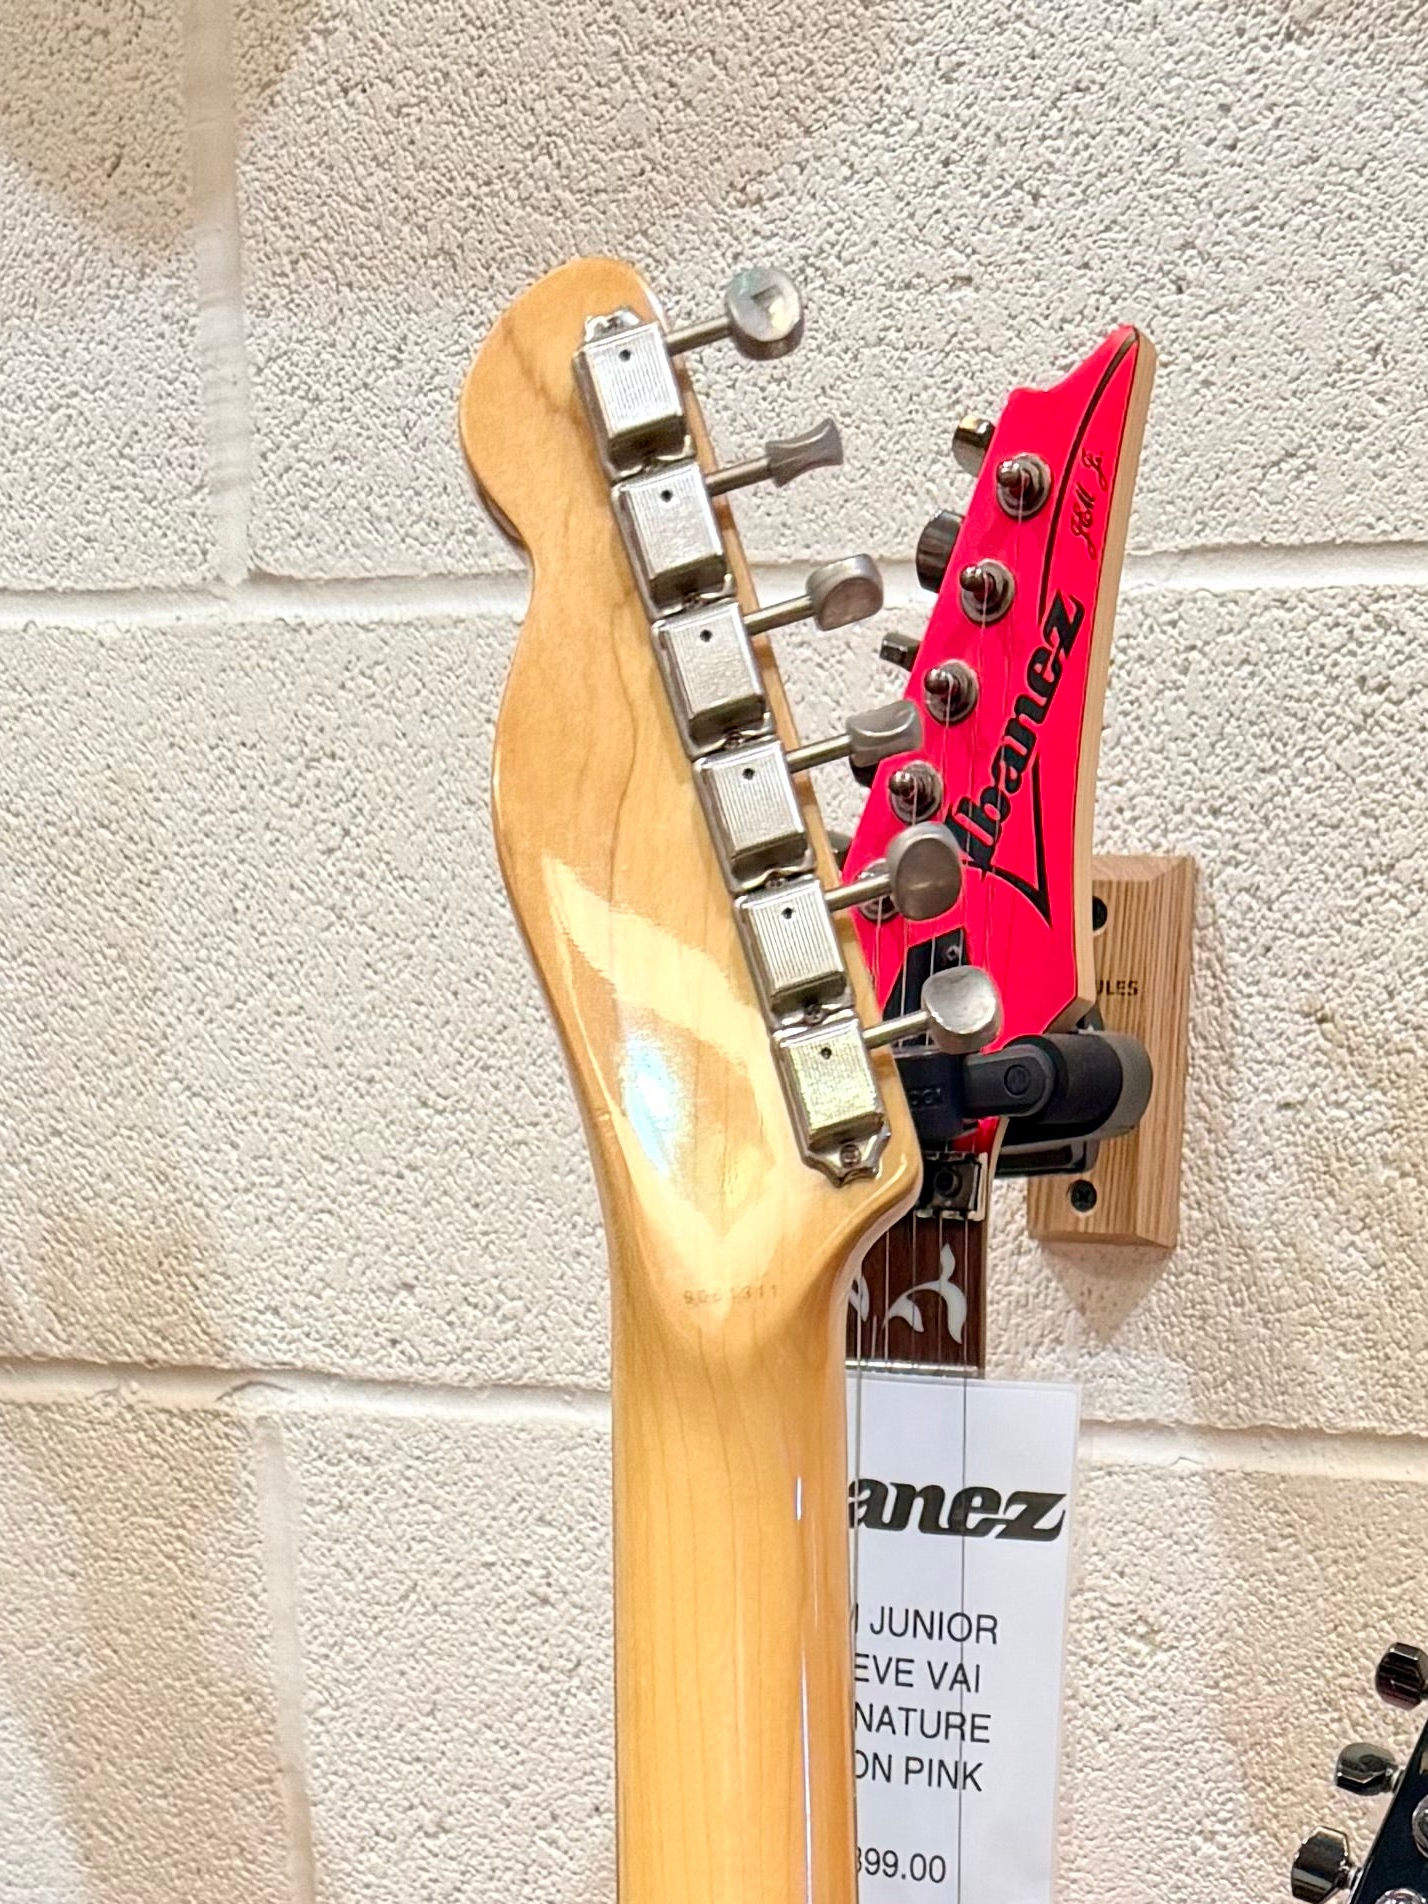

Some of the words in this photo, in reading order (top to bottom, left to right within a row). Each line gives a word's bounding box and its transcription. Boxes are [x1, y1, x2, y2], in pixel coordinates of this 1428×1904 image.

[943, 588, 1085, 883] Ibanez
[849, 1478, 1066, 1541] anez
[870, 1606, 997, 1644] JUNIOR
[855, 1652, 914, 1687] EVE
[927, 1660, 980, 1693] VAI
[855, 1701, 991, 1743] NATURE
[905, 1756, 983, 1791] PINK
[856, 1846, 946, 1883] 99.00
